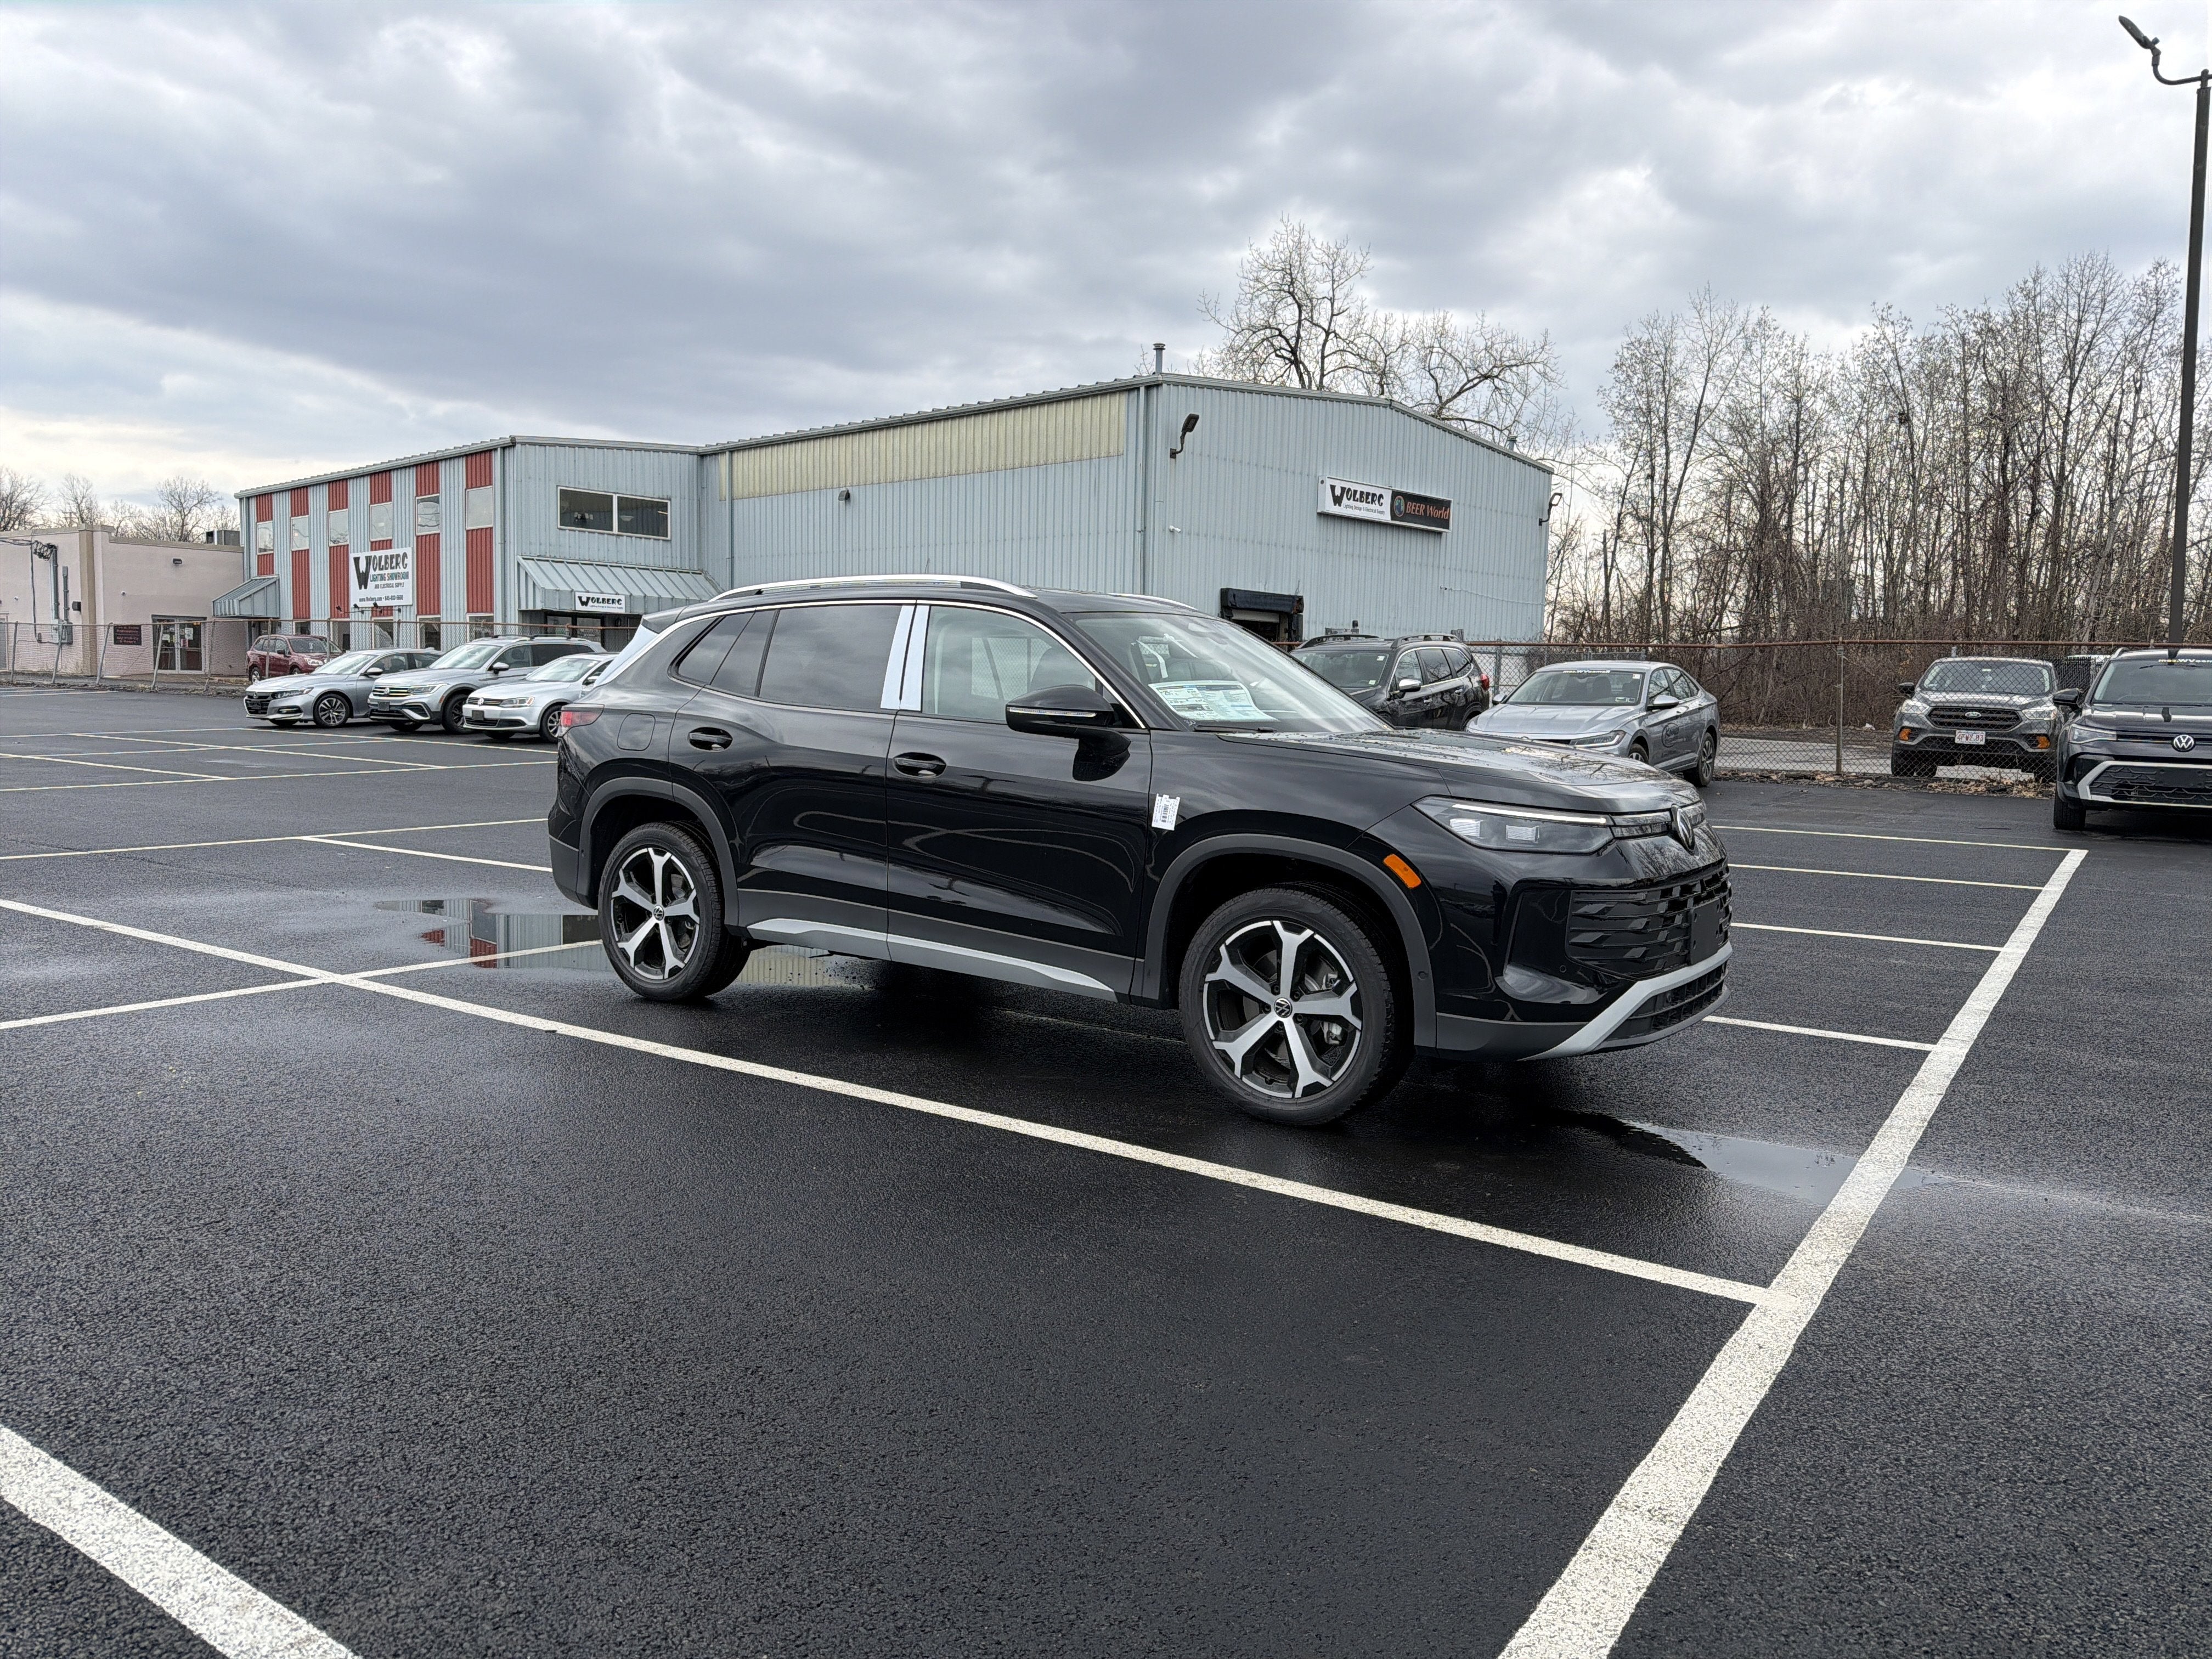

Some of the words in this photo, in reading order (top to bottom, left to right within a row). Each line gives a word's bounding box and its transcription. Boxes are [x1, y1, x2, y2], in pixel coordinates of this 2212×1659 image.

[1330, 484, 1384, 507] WOLBERG
[1406, 501, 1425, 516] BEER
[1427, 504, 1449, 520] World
[353, 552, 408, 590] WOLBERG
[370, 573, 386, 582] LIGHTING
[387, 571, 409, 581] SHOWROOM
[578, 596, 623, 607] WOLBERG
[2174, 735, 2194, 750] VW
